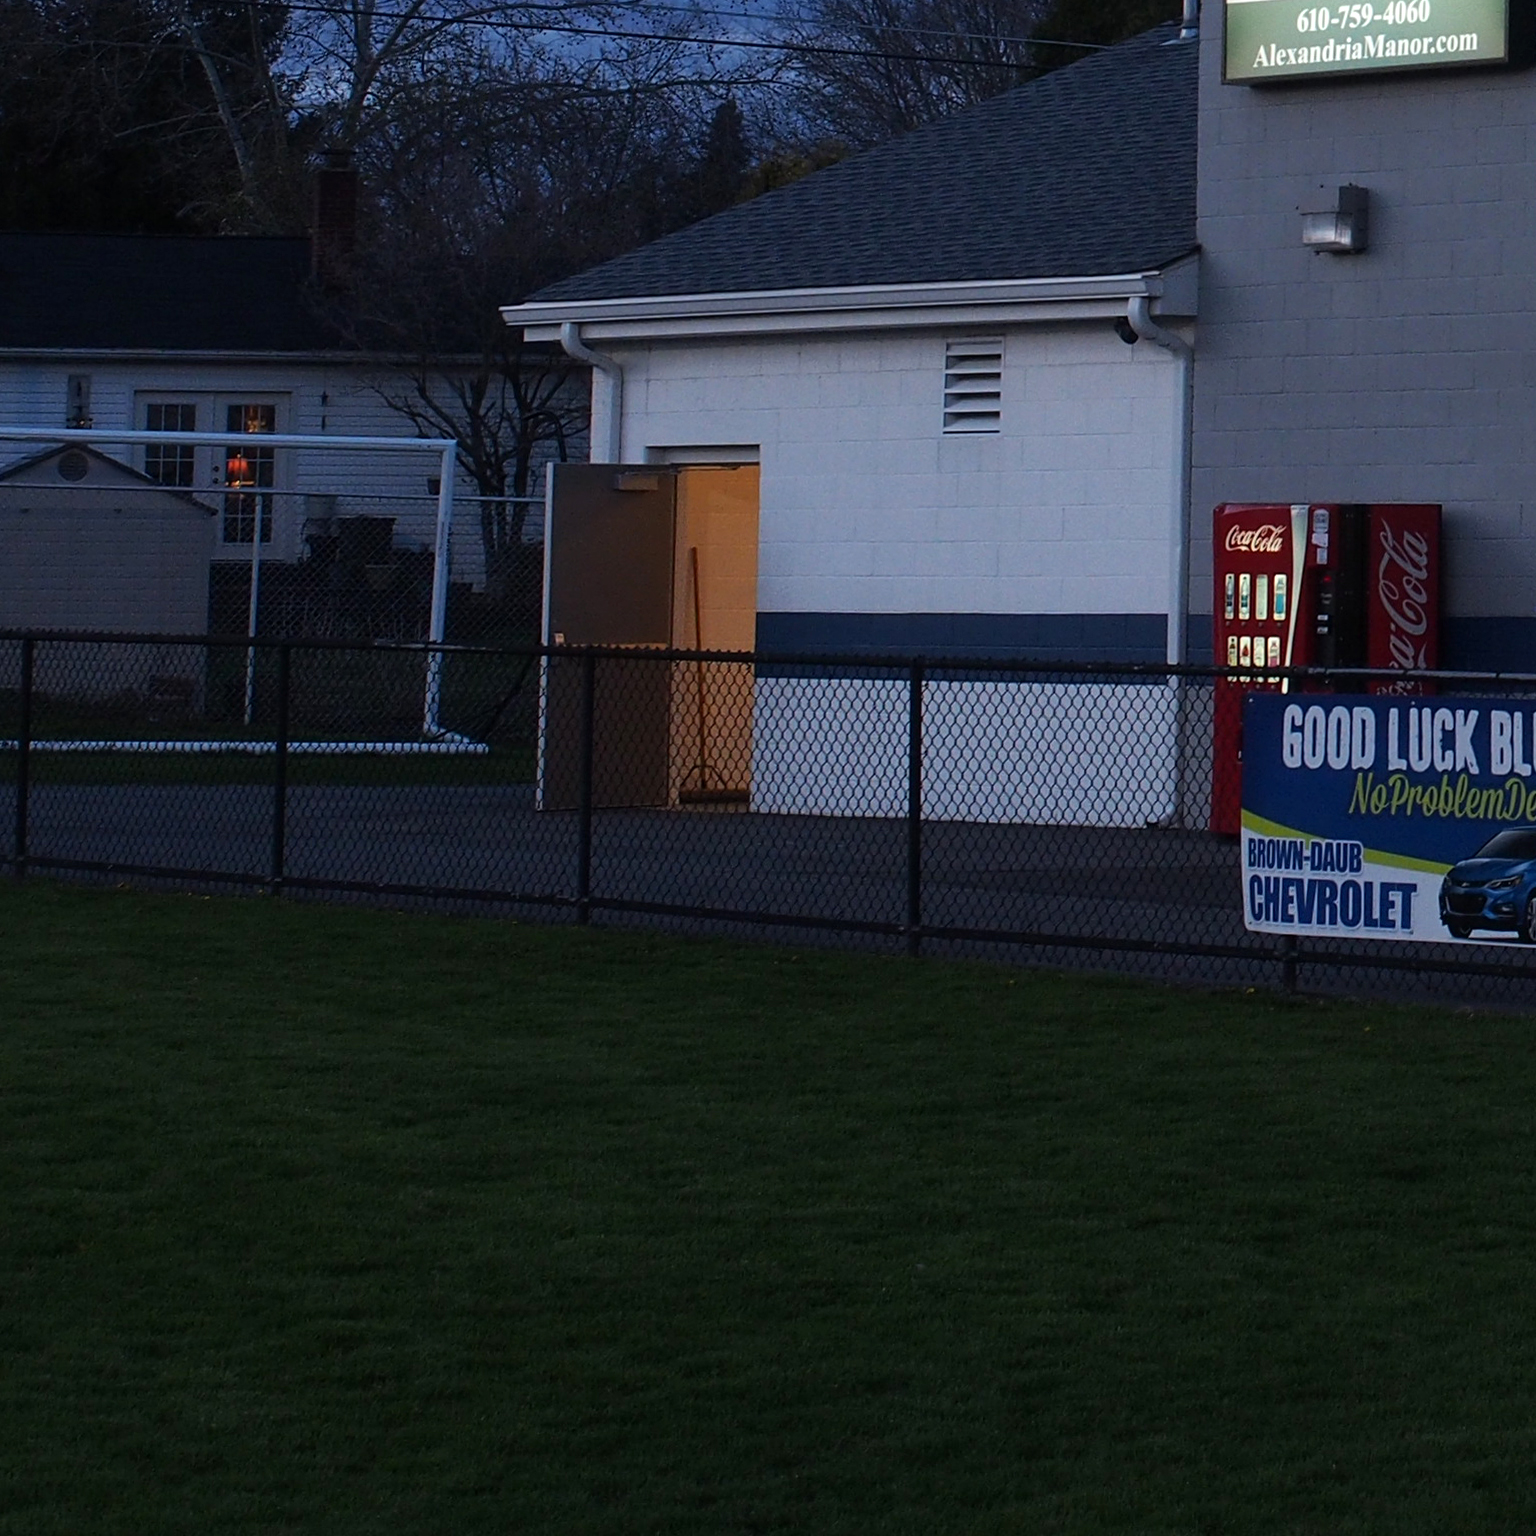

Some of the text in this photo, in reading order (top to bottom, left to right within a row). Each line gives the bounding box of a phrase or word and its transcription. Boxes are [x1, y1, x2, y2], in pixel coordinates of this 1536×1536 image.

[1252, 32, 1478, 68] AlexandriaManor.com
[1225, 524, 1287, 553] Coca-Cola
[1283, 705, 1375, 770] GOOD
[1388, 707, 1479, 775] LUCK
[1248, 838, 1362, 873] BROWN-DAUB
[1250, 875, 1417, 929] CHEVROLET
